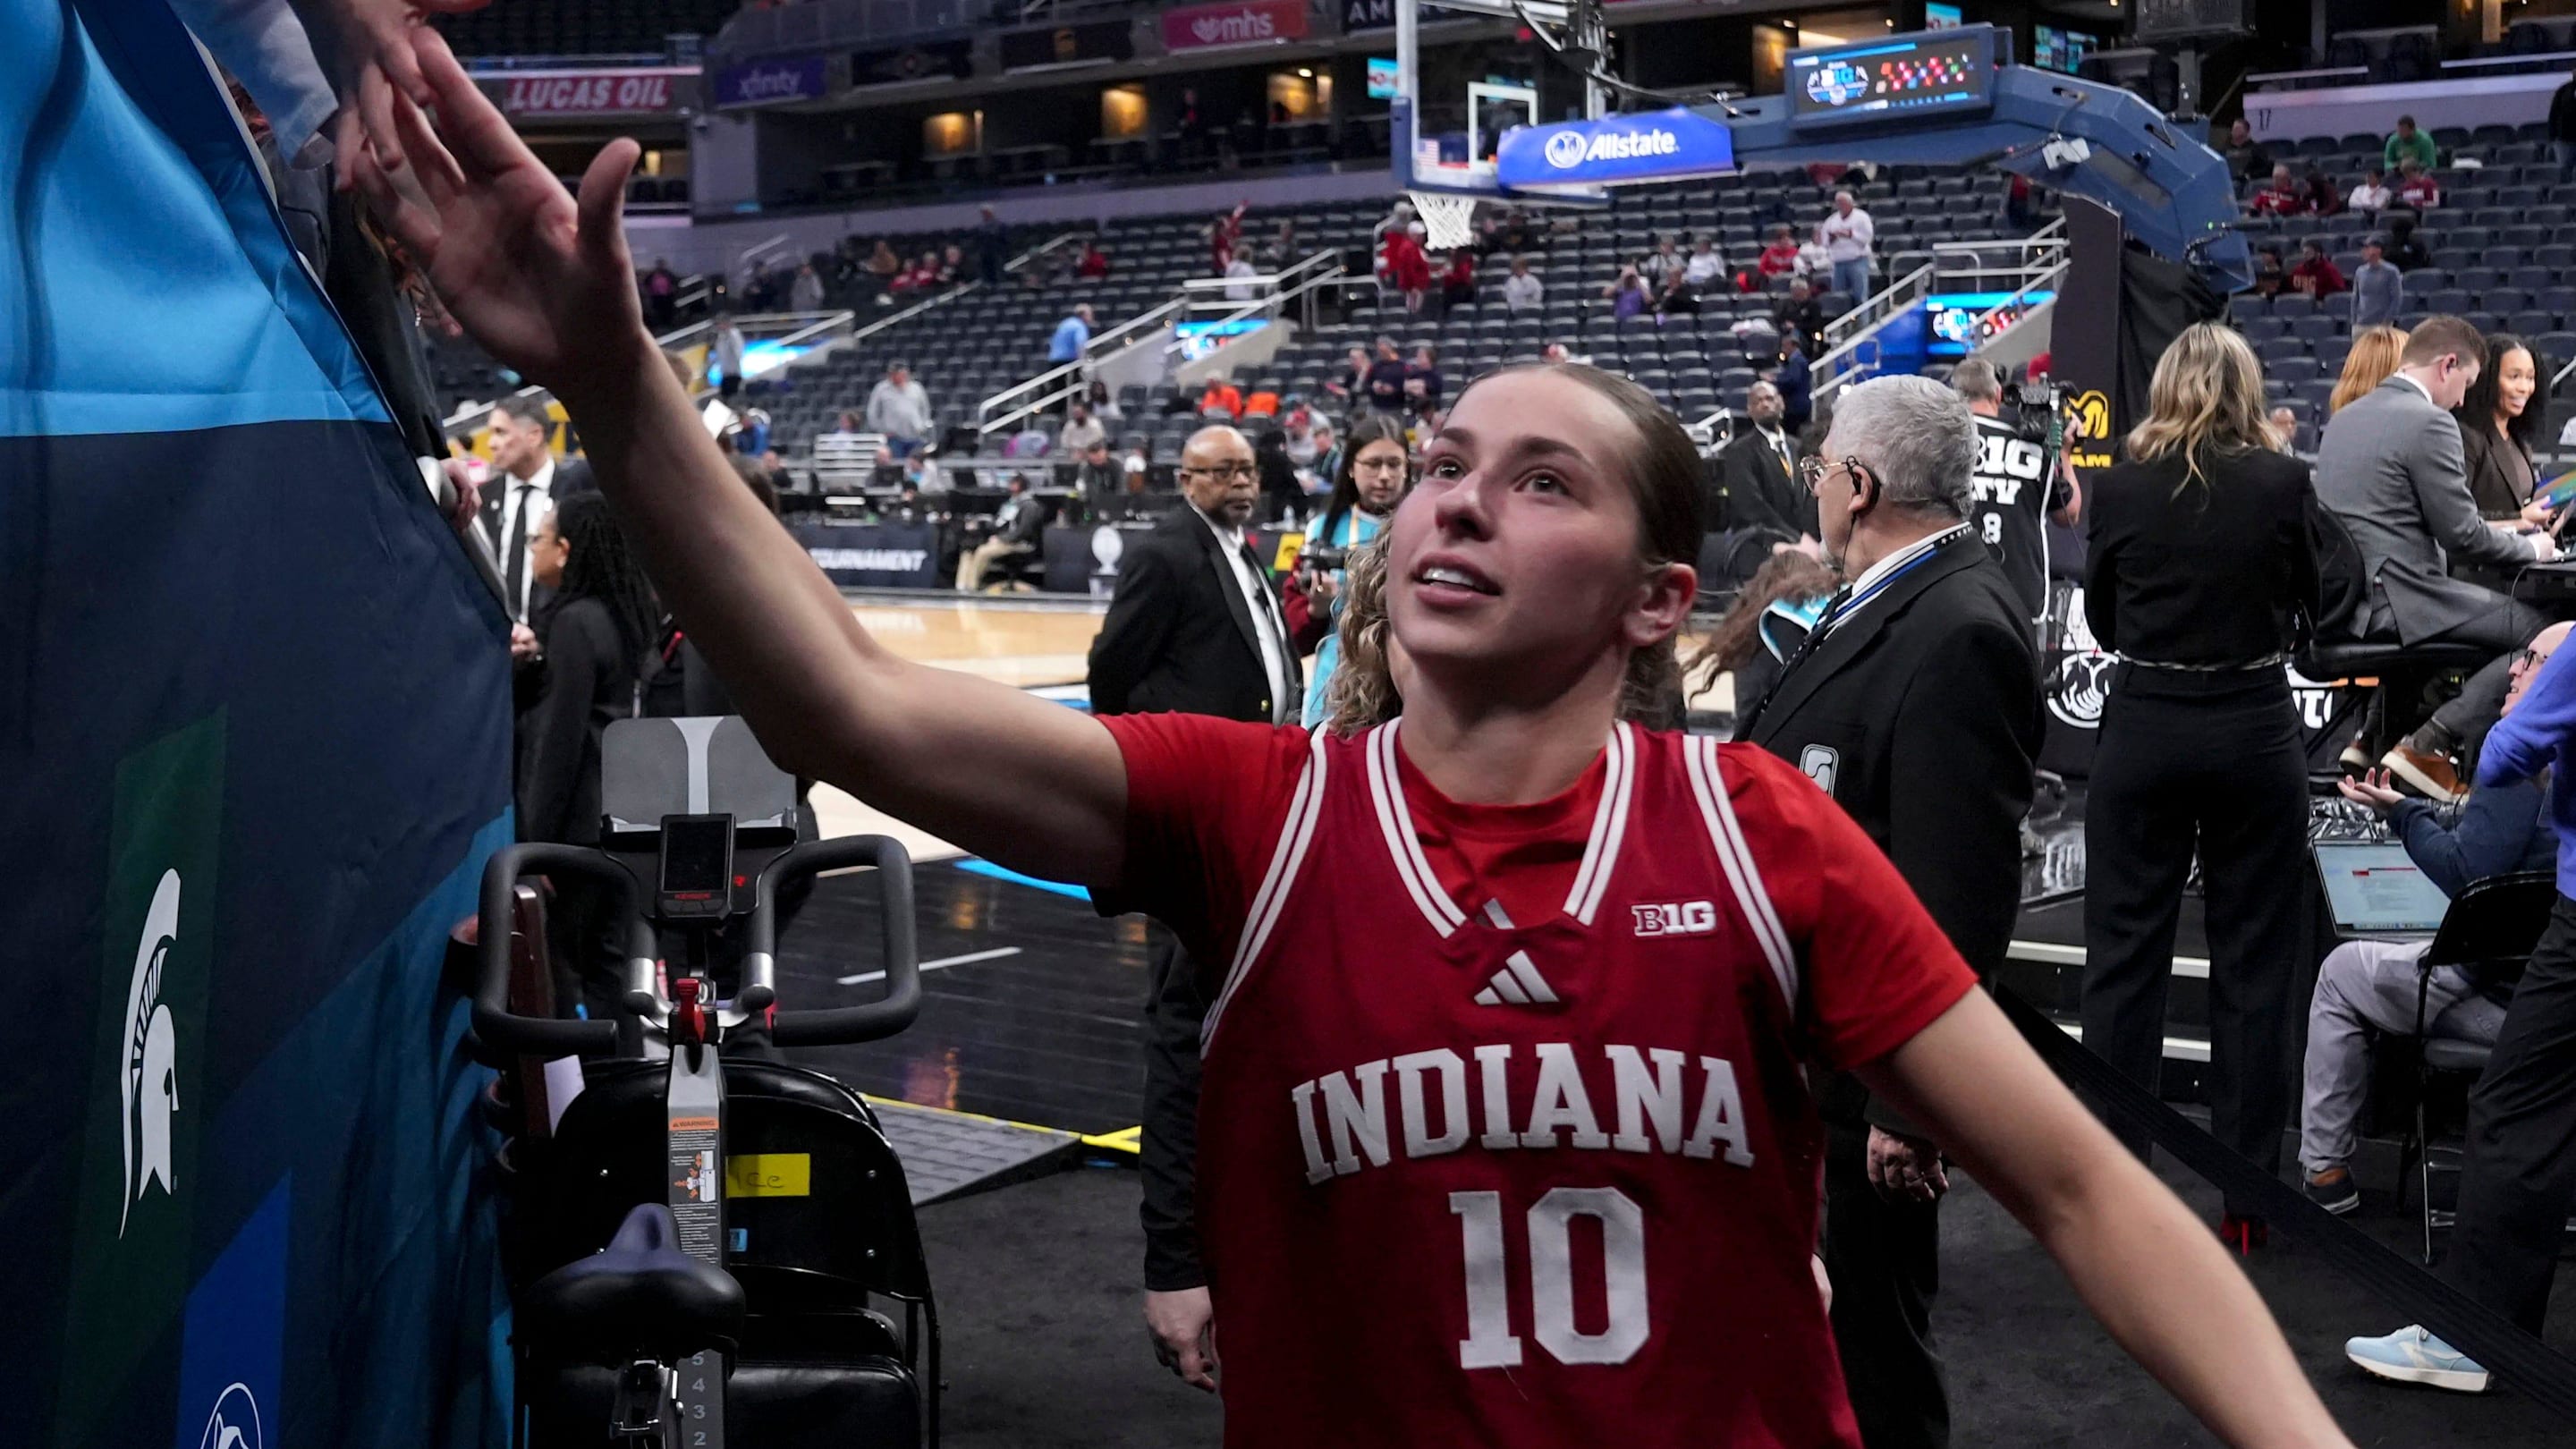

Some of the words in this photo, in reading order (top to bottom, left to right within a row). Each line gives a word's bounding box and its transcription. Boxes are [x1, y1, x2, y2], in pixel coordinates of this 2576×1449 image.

[1222, 7, 1275, 38] mhs
[511, 78, 613, 110] LUCAS
[619, 78, 669, 106] OIL
[1586, 128, 1677, 161] Allstate
[2069, 453, 2112, 468] AM
[1292, 1043, 1755, 1186] INDIANA
[1448, 1186, 1651, 1369] 10
[691, 1377, 706, 1393] 4
[693, 1404, 706, 1419] 3
[693, 1431, 707, 1446] 2
